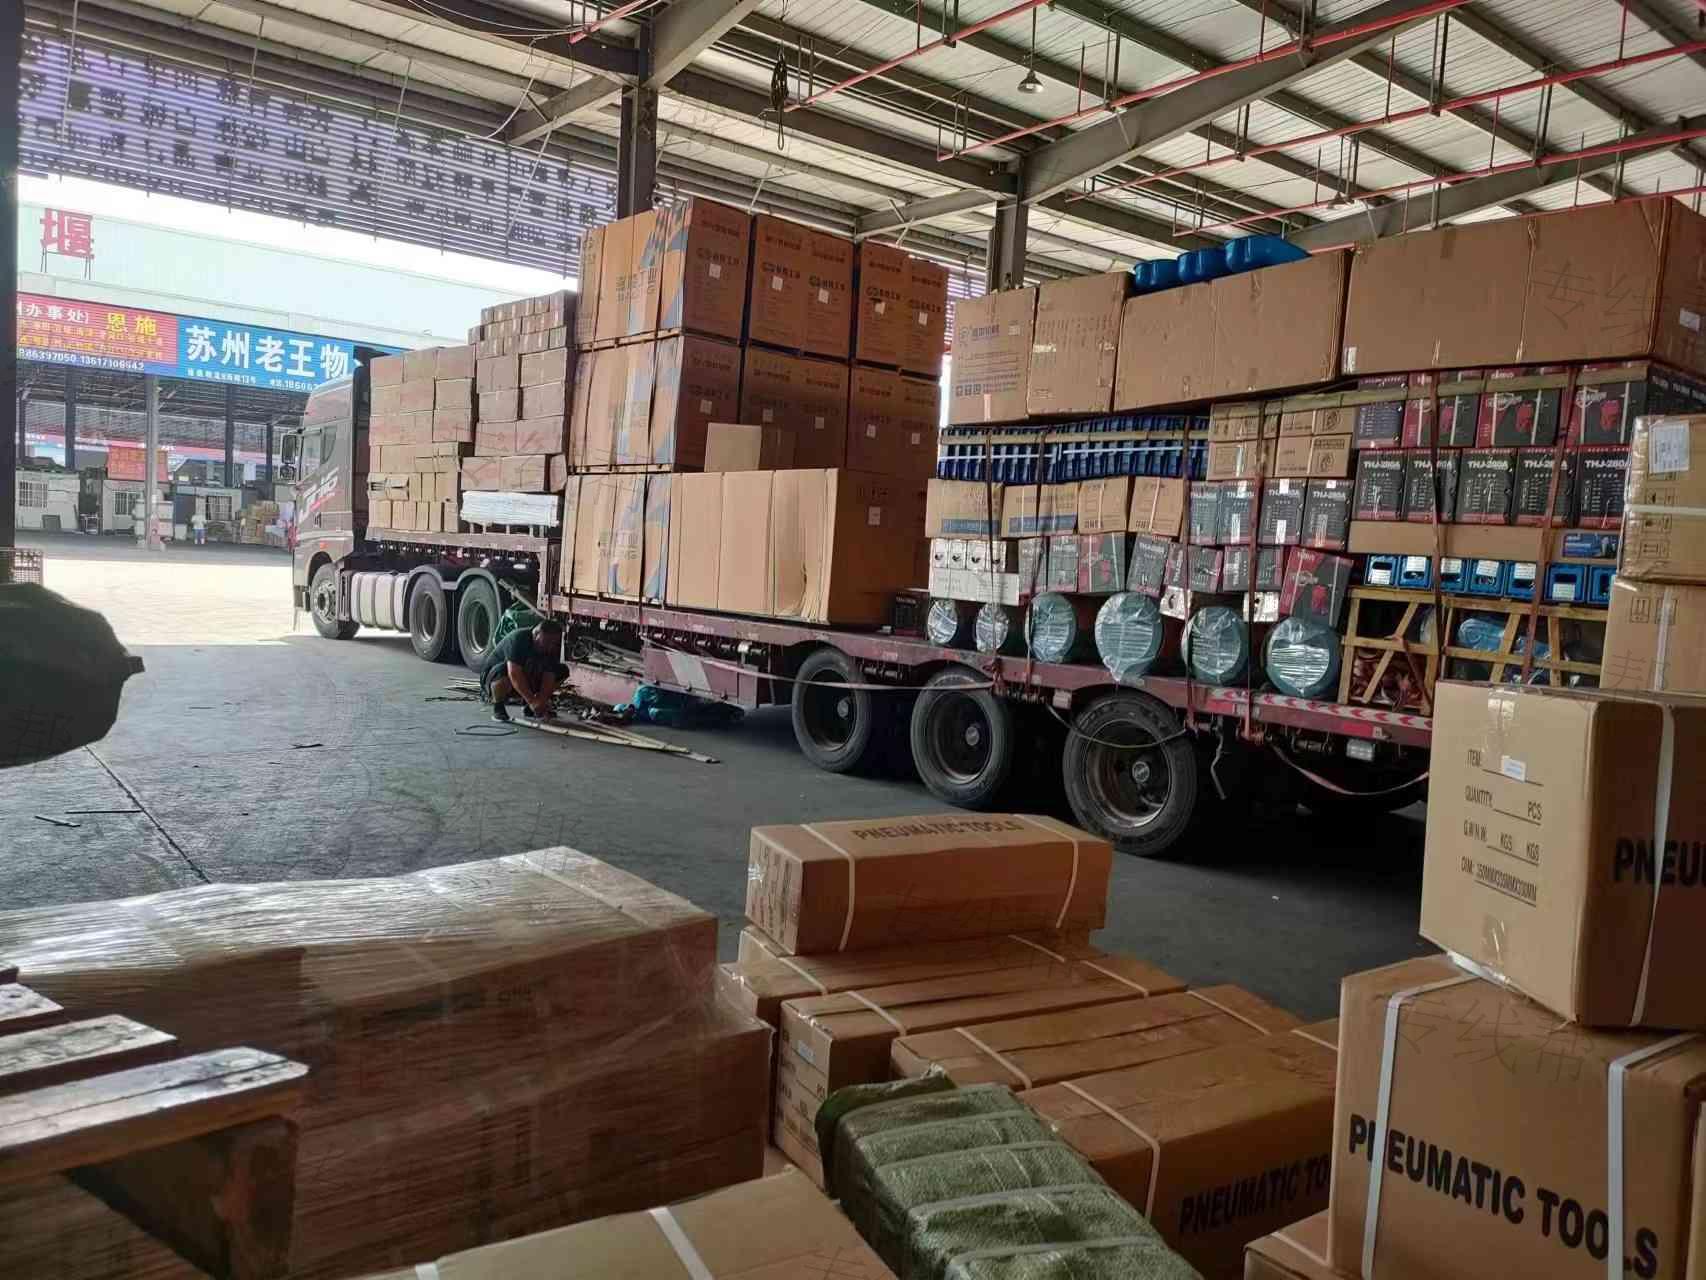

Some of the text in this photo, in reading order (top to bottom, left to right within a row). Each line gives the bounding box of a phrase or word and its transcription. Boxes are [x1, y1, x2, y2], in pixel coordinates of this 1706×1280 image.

[106, 312, 157, 337] 恩施
[186, 325, 350, 380] 苏州老王物
[1527, 801, 1543, 821] PCS
[1526, 841, 1540, 862] KGS
[1613, 836, 1706, 886] PNEU
[1178, 1163, 1297, 1235] PNEUMATIC
[1536, 1187, 1659, 1279] TOOS
